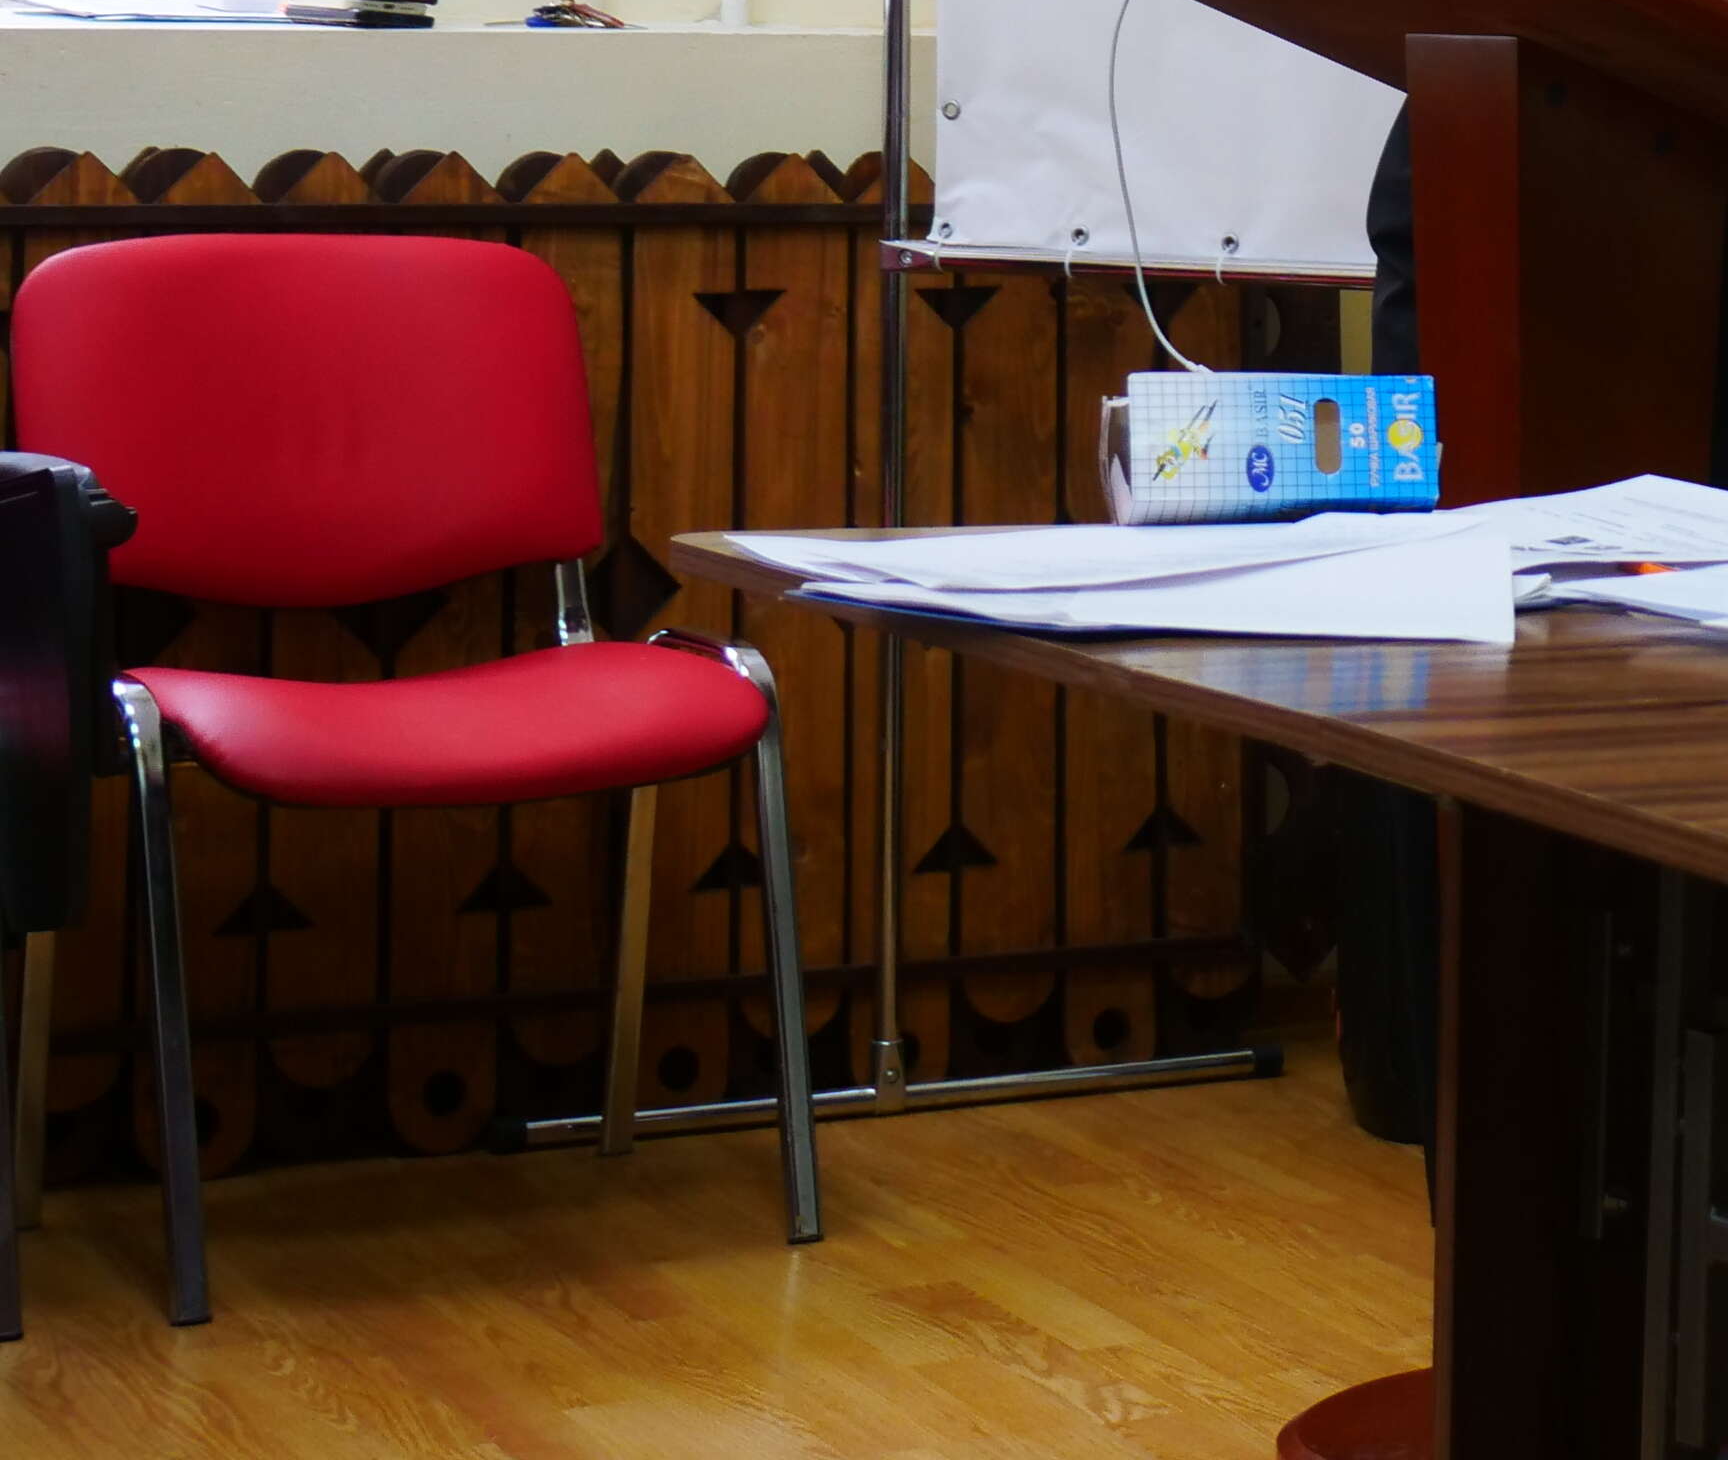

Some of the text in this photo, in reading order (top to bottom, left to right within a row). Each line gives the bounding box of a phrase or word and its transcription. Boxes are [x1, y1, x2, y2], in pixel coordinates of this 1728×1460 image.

[1256, 389, 1268, 438] BASIR
[1277, 393, 1307, 445] 051
[1349, 422, 1366, 449] 50
[1391, 392, 1424, 482] BASIR
